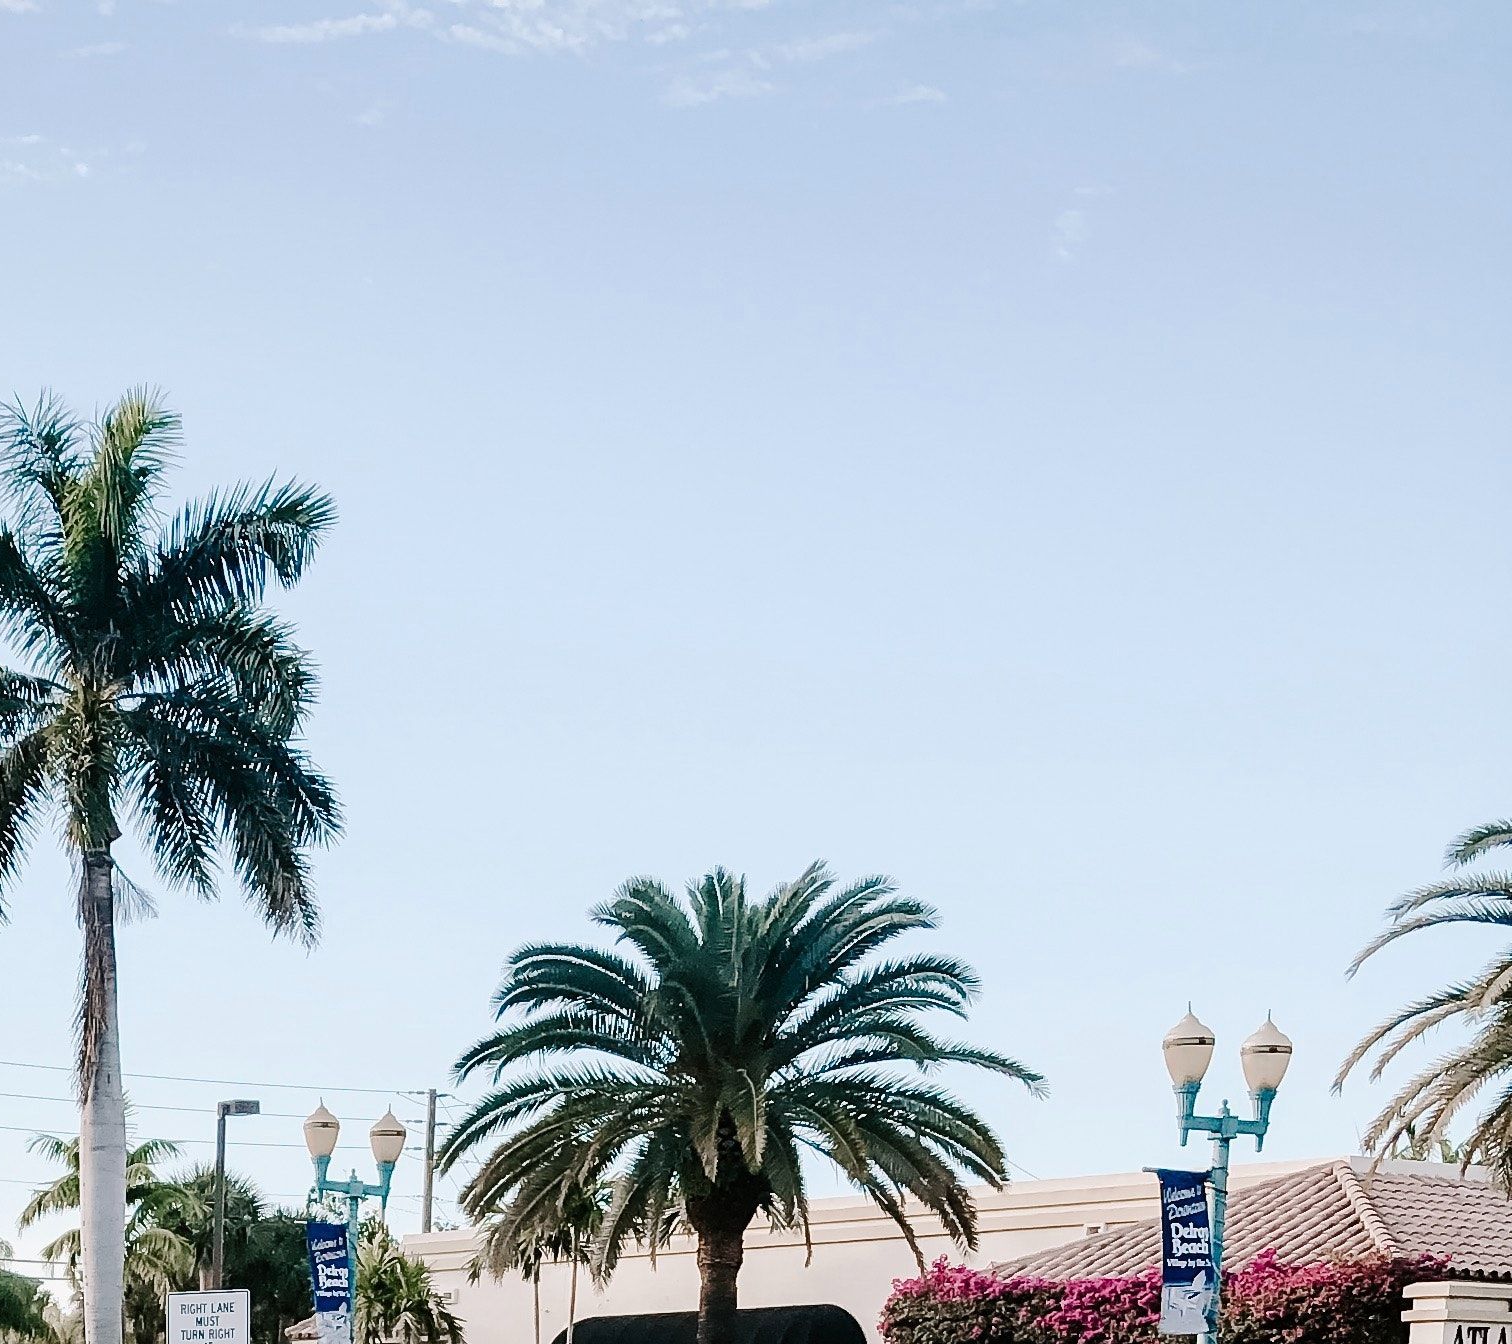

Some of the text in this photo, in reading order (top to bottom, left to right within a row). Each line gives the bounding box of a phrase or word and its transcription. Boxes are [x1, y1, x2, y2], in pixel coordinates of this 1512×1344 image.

[1171, 1222, 1209, 1241] Delray
[1172, 1239, 1209, 1256] Beach
[180, 1302, 235, 1314] RIGHT LANE
[195, 1316, 220, 1327] MUST
[181, 1328, 235, 1340] TURN RIGHT
